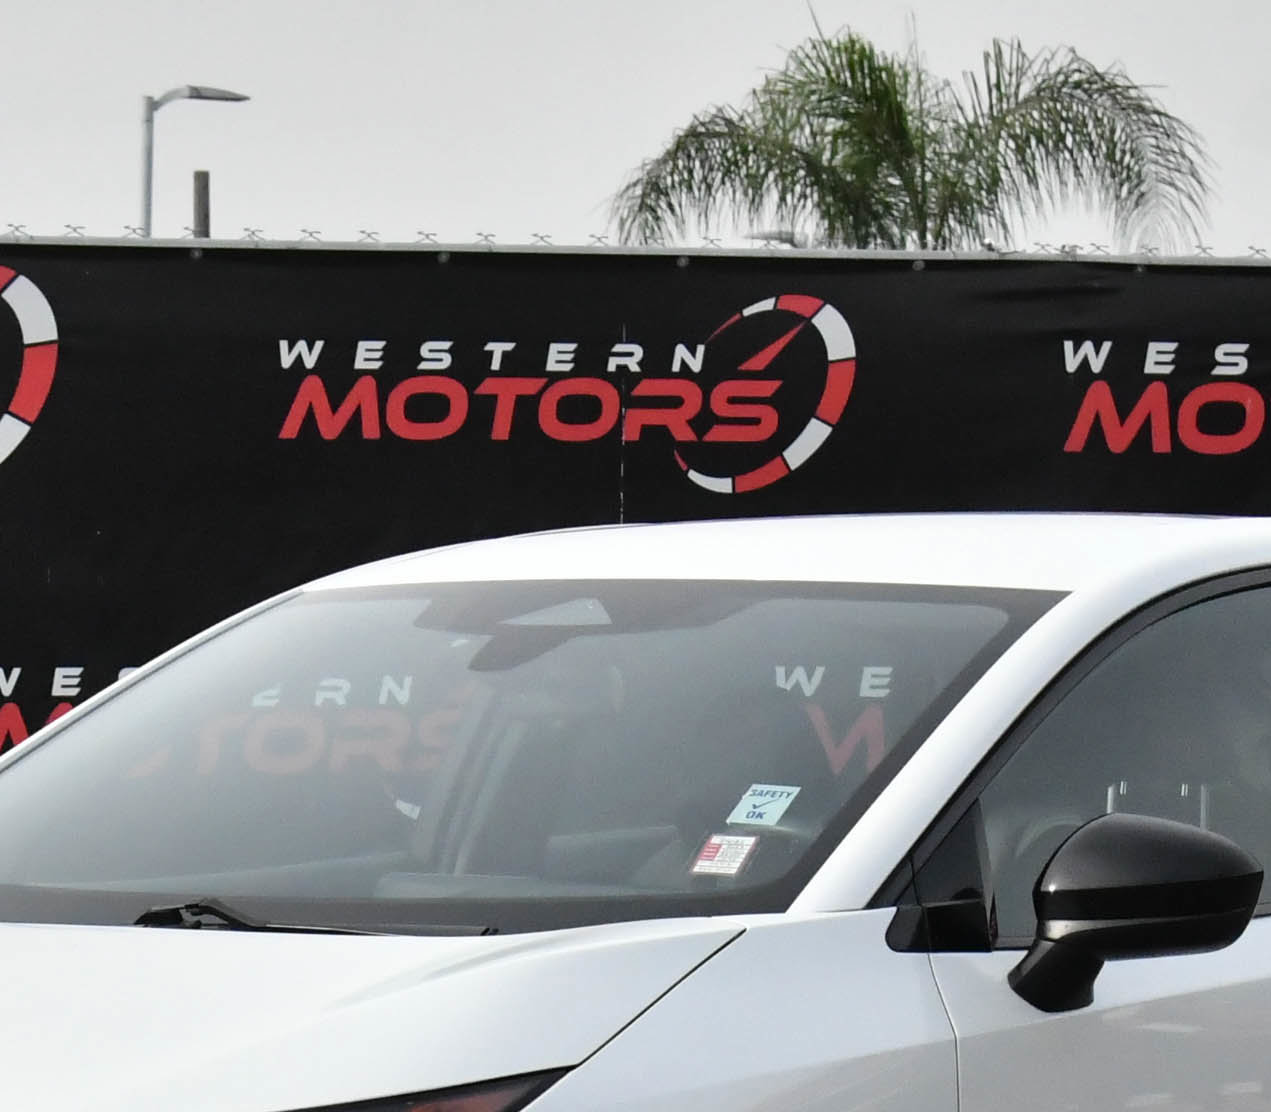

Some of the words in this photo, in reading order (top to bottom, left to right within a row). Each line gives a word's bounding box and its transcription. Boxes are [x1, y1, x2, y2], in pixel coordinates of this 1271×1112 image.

[279, 338, 706, 373] WESTERN
[278, 374, 783, 443] MOTORS
[748, 789, 794, 799] SAFETY
[745, 811, 767, 820] OK
